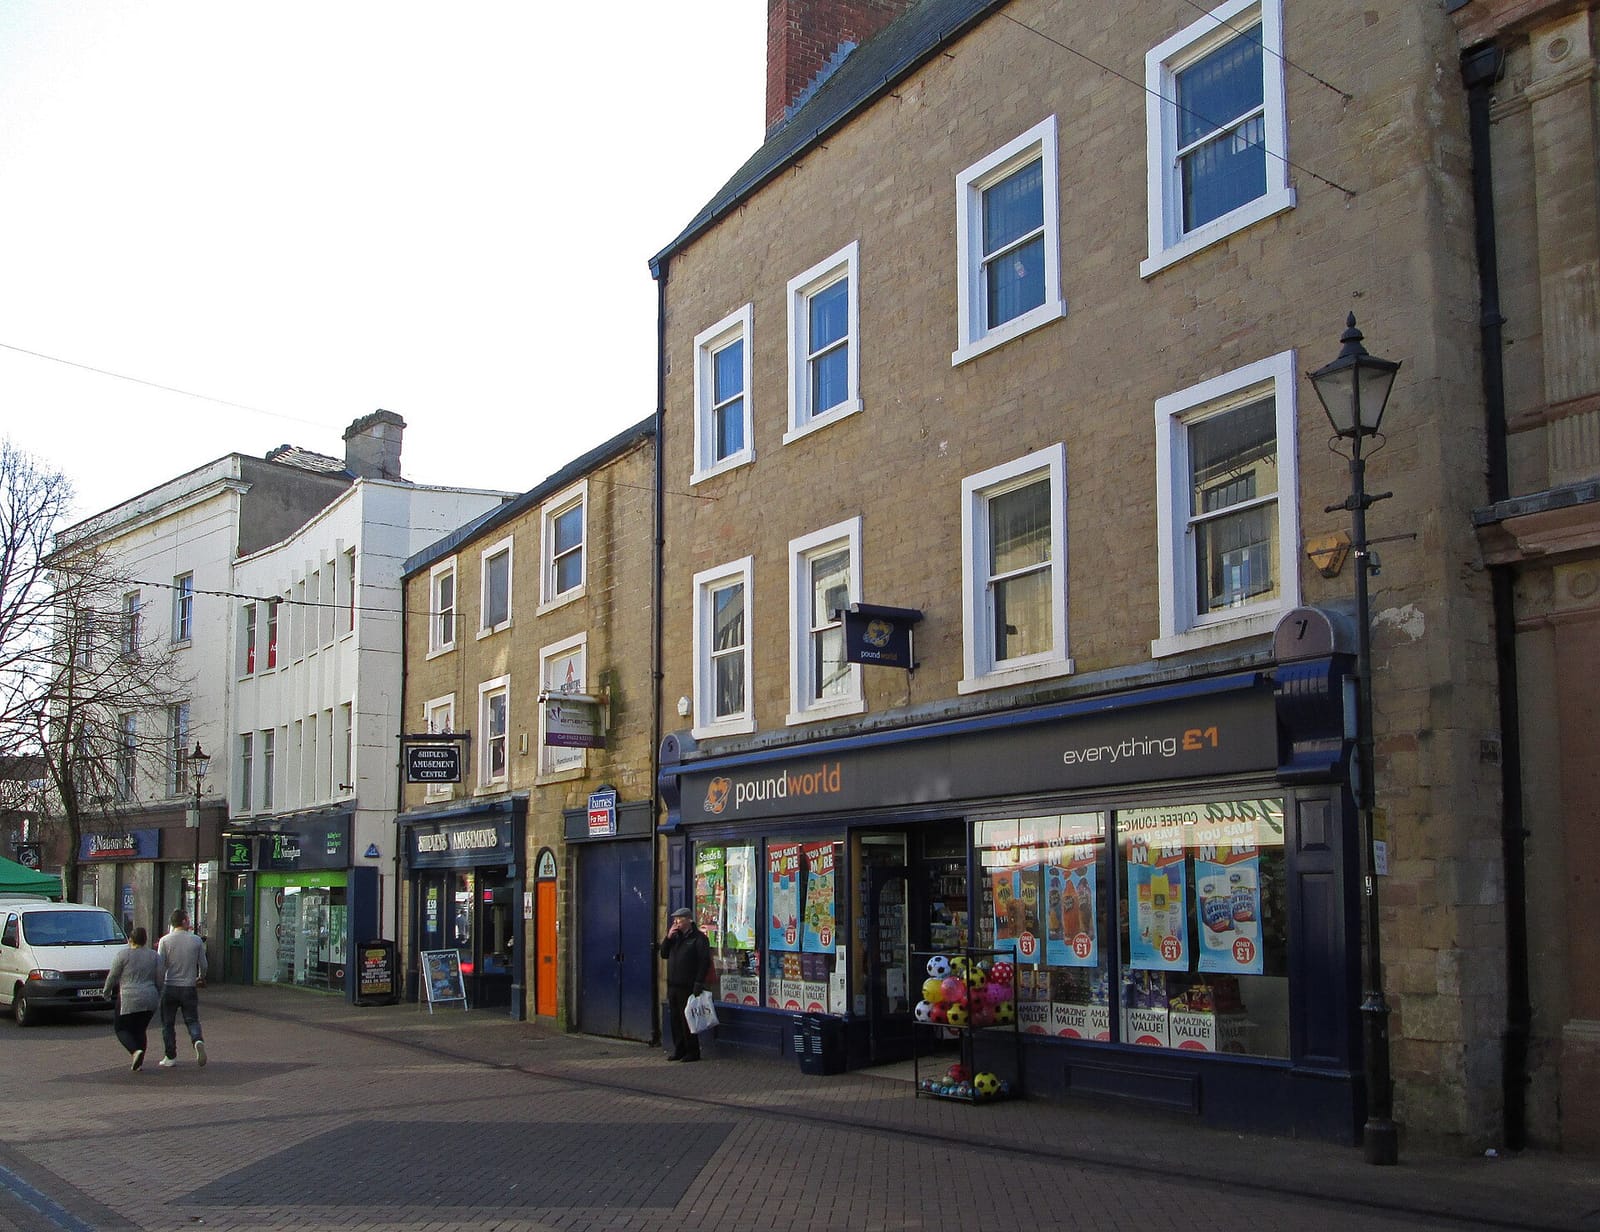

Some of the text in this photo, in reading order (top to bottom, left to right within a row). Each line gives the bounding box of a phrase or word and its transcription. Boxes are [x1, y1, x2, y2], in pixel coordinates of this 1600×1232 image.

[1295, 618, 1309, 640] 7
[1063, 726, 1218, 765] everything £1
[412, 760, 455, 769] AMUSEMENT
[420, 770, 447, 778] CENTRE
[735, 762, 841, 810] poundworld
[1130, 826, 1181, 846] YOU SAVE
[1198, 822, 1254, 842] YOU SAVE
[453, 827, 497, 850] AMUSEMENTS
[700, 850, 716, 861] Seeds
[770, 846, 797, 860] YOU SAVE
[806, 845, 832, 860] YOU SAVE
[1022, 941, 1032, 953] £1
[1076, 943, 1088, 955] £1
[1235, 940, 1250, 948] ONLY
[1164, 945, 1177, 959] £1
[1236, 947, 1250, 961] £1
[805, 984, 825, 993] AMAZING
[806, 992, 825, 1001] VALUE!
[1021, 1013, 1048, 1023] VALUE!
[1054, 1006, 1087, 1018] AMAZING
[1130, 1011, 1165, 1023] AMAZING
[1055, 1015, 1085, 1027] VALUE!
[1131, 1020, 1164, 1033] VALUE!
[1172, 1016, 1212, 1028] AMAZING
[1175, 1025, 1210, 1039] VALUE!
